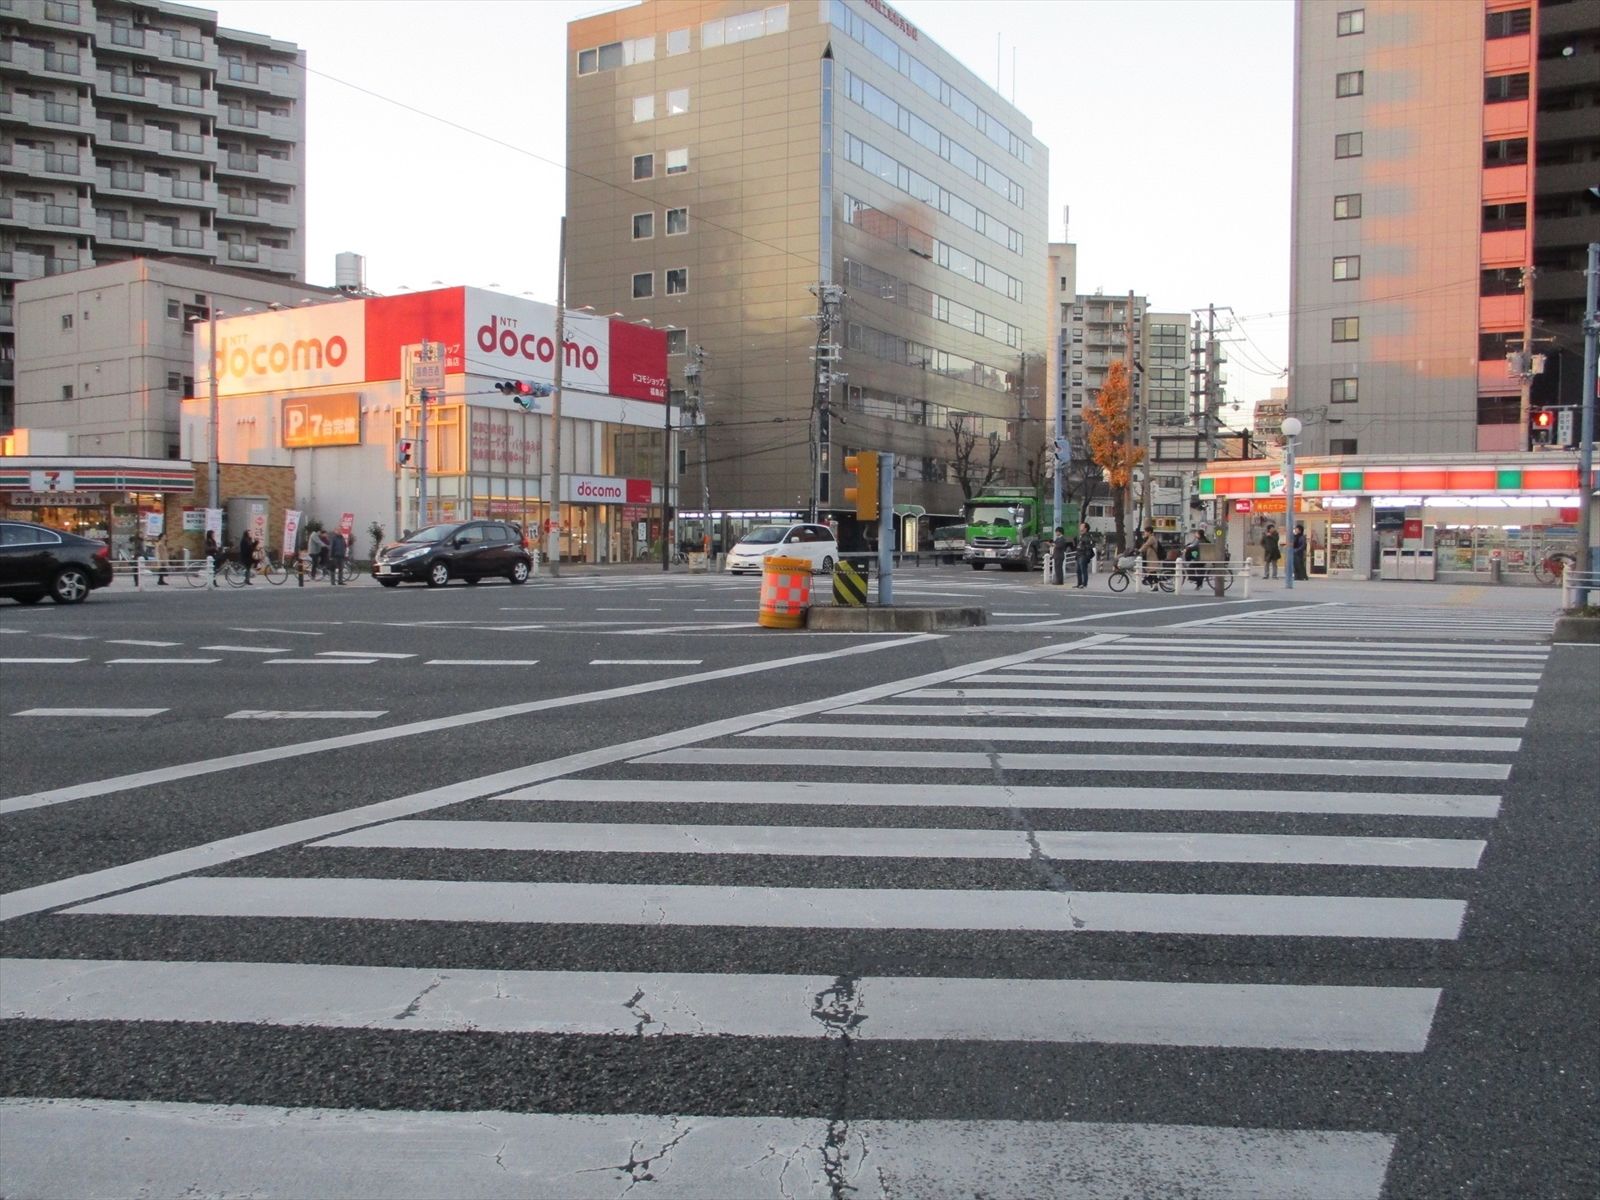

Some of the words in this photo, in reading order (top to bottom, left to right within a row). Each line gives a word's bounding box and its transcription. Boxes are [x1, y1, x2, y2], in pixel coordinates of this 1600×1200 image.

[500, 316, 518, 328] NTT
[230, 334, 248, 346] NTT
[477, 315, 599, 371] docomo
[208, 335, 348, 379] docomo
[289, 410, 304, 437] P
[577, 482, 622, 498] docomo
